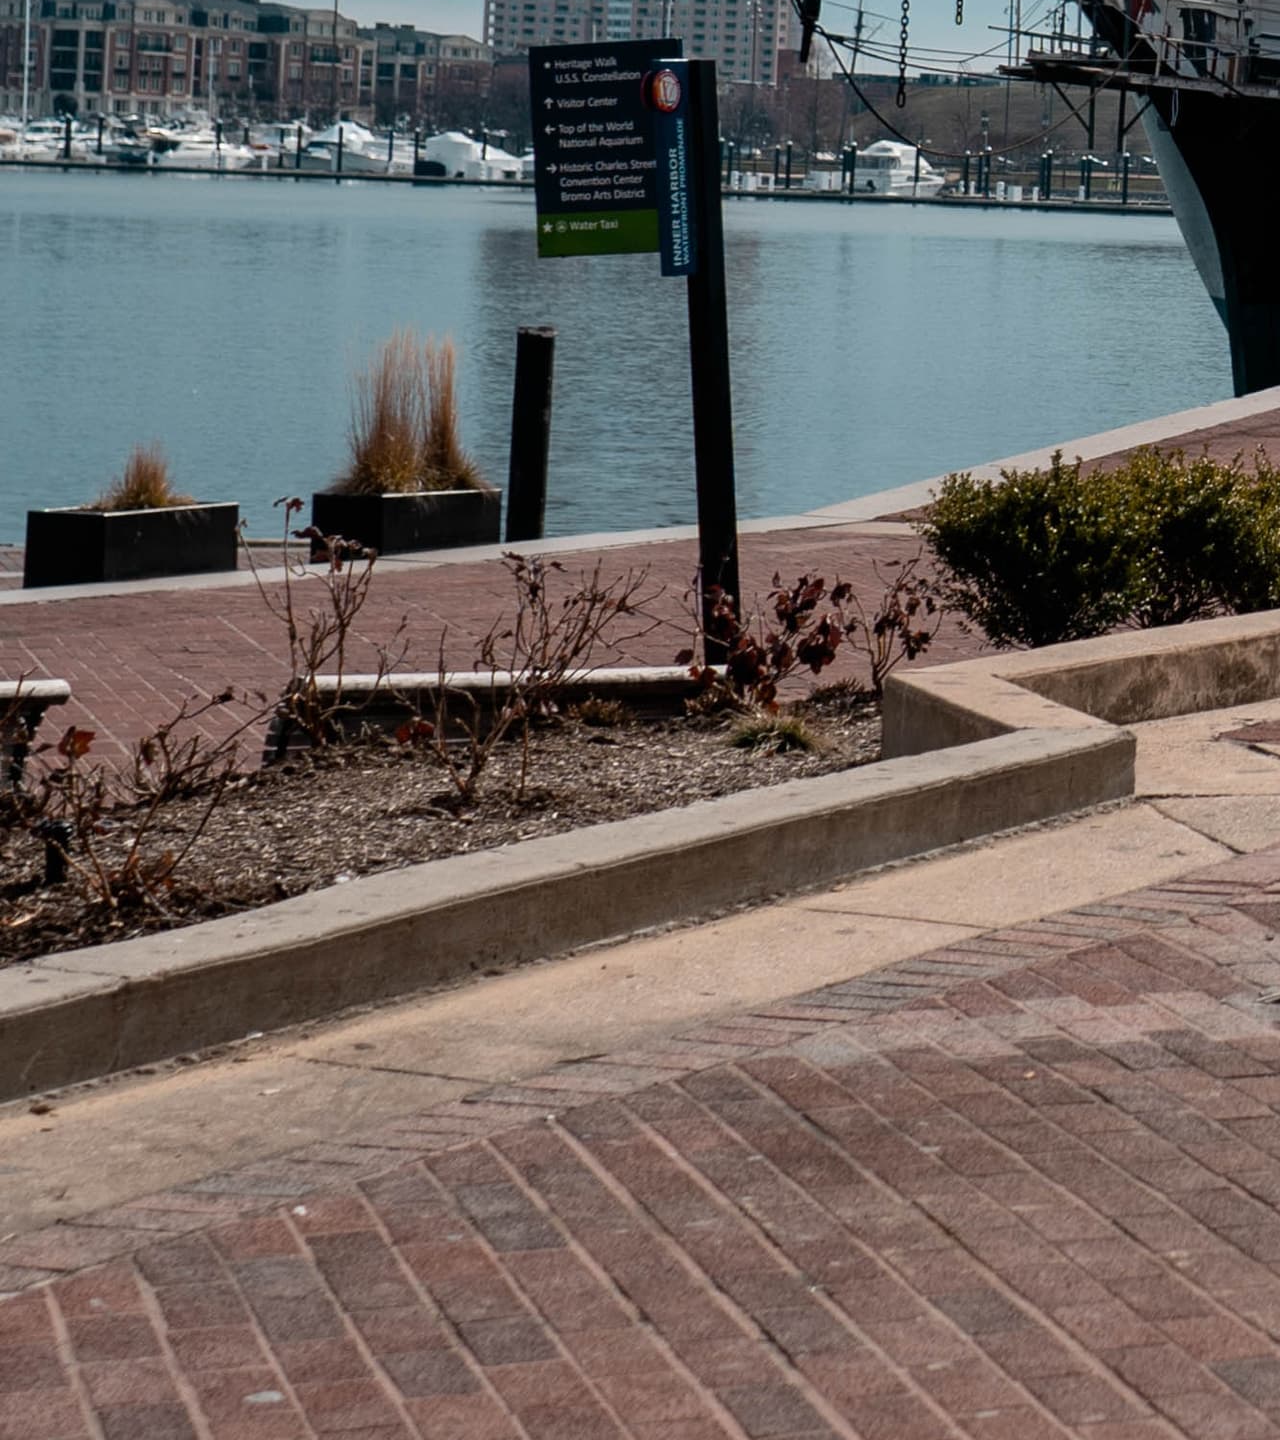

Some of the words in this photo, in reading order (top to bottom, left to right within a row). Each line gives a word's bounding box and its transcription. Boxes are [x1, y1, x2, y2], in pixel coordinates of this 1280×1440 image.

[554, 59, 592, 70] Heritage
[594, 56, 617, 67] Walk
[555, 73, 579, 84] U.S.S.
[582, 71, 641, 82] Constellation
[557, 98, 585, 108] Visitor
[587, 97, 618, 107] Center
[558, 123, 575, 135] Top
[576, 122, 586, 133] of
[588, 122, 604, 133] the
[606, 120, 634, 132] World
[559, 137, 597, 148] National
[599, 136, 643, 148] Aquarium
[675, 118, 687, 188] PROMENADE
[560, 162, 593, 173] Historic
[595, 159, 628, 171] Charles
[630, 159, 657, 170] Street
[560, 176, 611, 187] Convention
[613, 174, 643, 185] Center
[668, 148, 680, 214] HARBOR
[560, 192, 591, 202] Bromo
[593, 190, 612, 200] Arts
[613, 189, 645, 199] District
[569, 221, 598, 231] Water
[599, 219, 619, 230] Taxi
[679, 191, 689, 265] WATERFRONT
[672, 220, 682, 266] INNER
